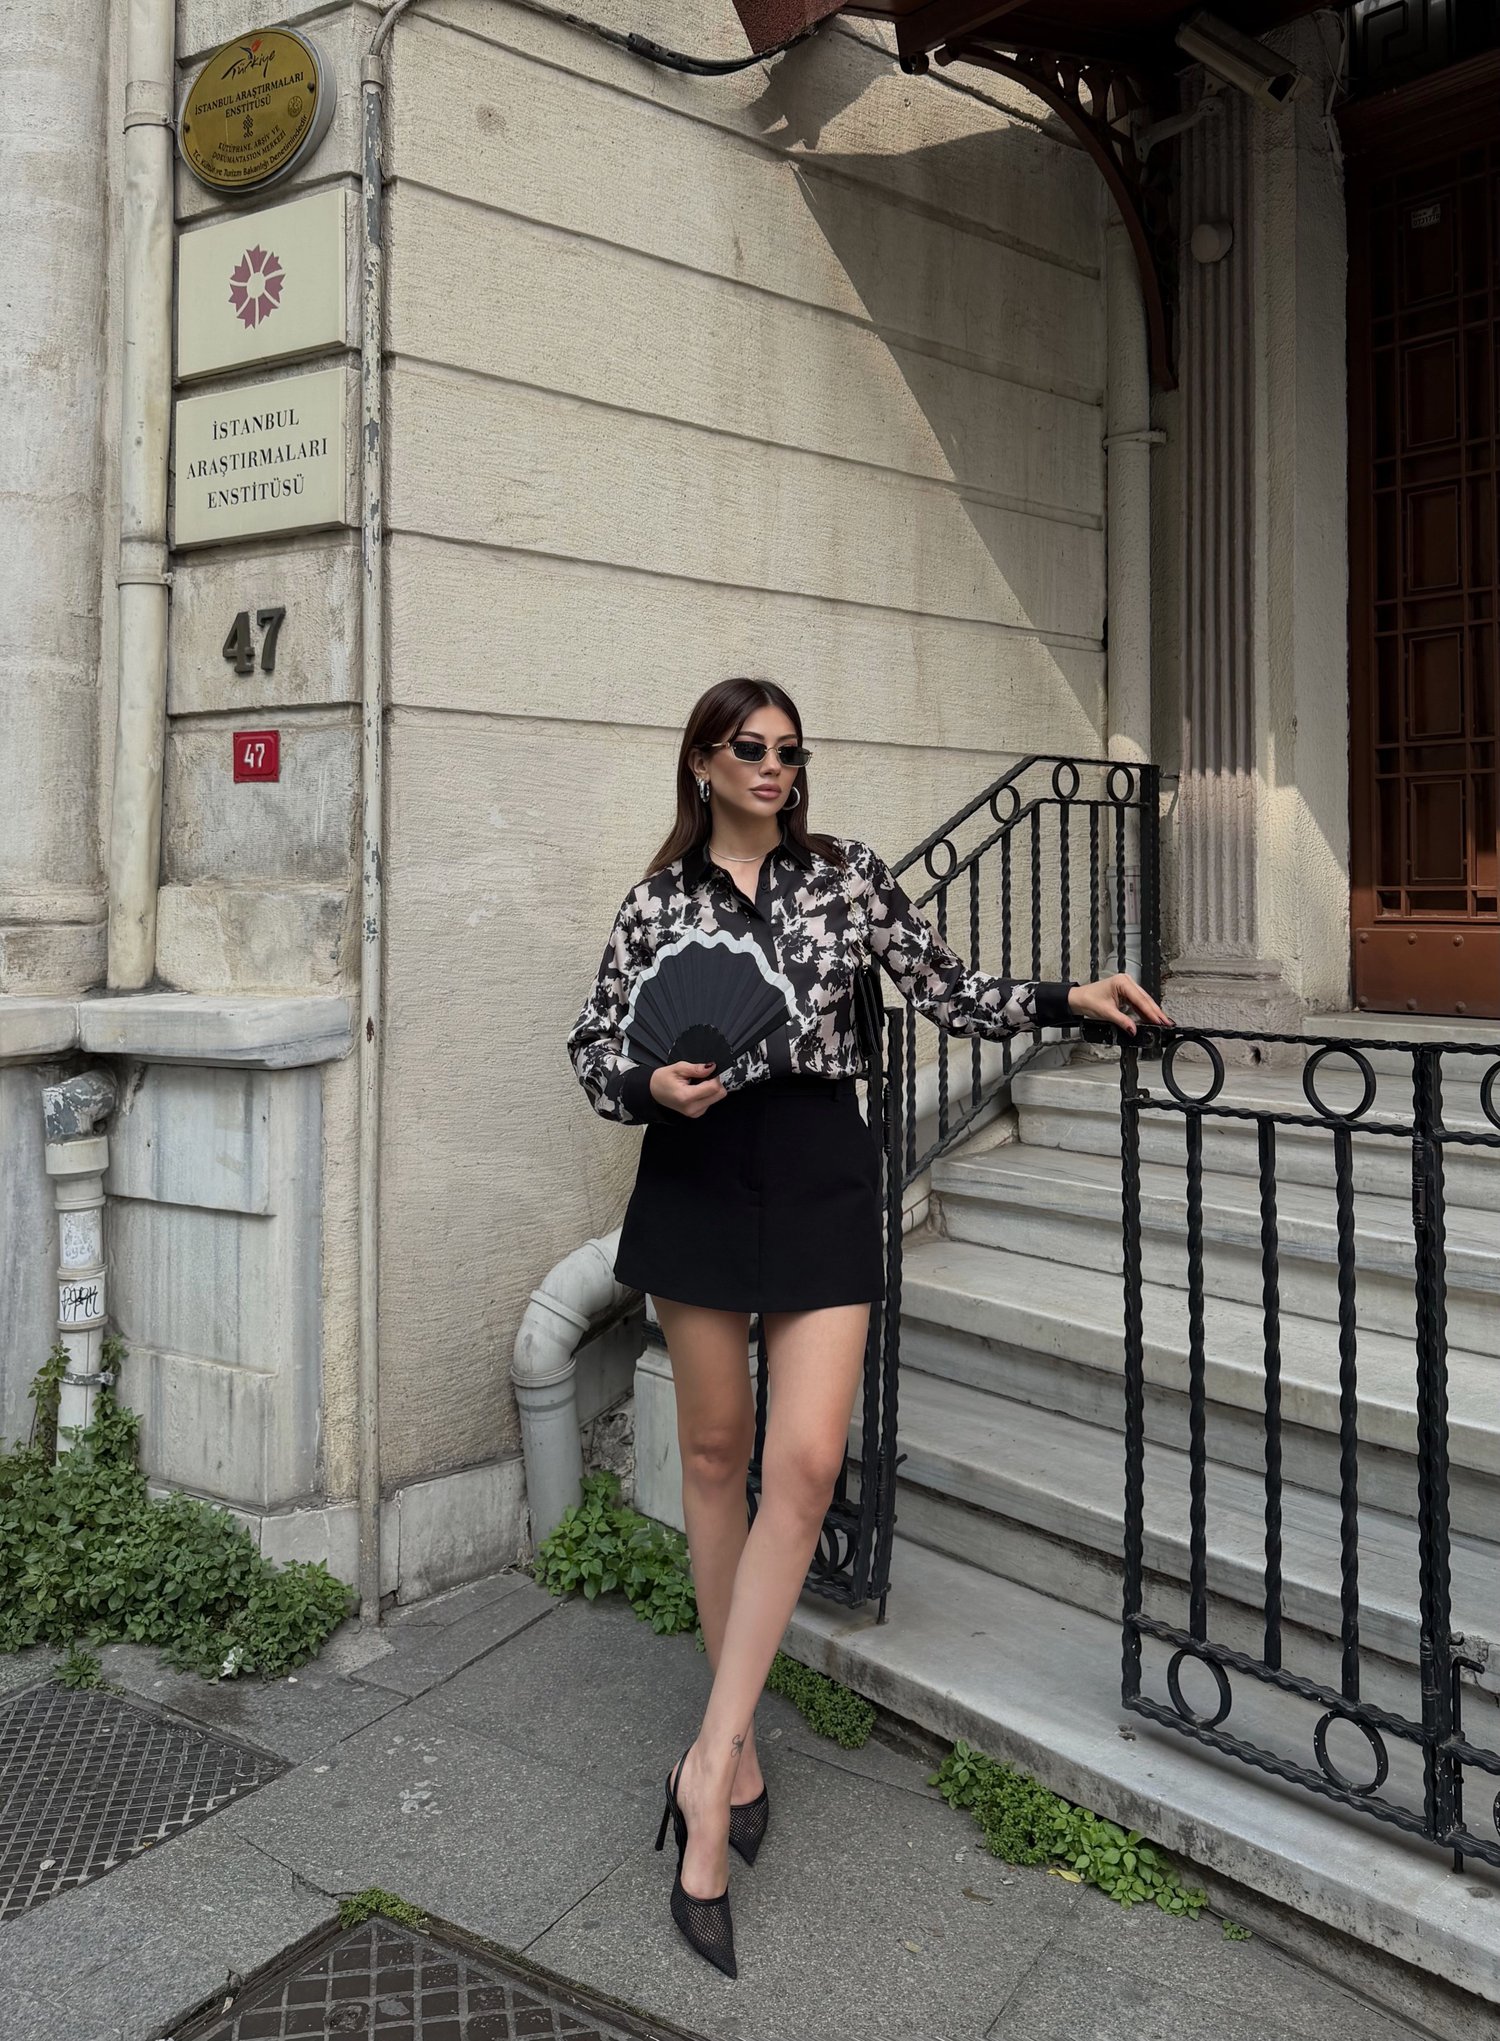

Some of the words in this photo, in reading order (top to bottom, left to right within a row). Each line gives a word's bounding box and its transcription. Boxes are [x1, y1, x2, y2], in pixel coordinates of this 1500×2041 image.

[221, 49, 276, 80] Türkiye
[195, 95, 234, 115] İSTANBUL
[235, 71, 304, 102] ARAŞTIRMALARI
[225, 95, 271, 118] ENSTİTÜSÜ
[270, 114, 308, 166] Denetimindedir
[212, 408, 299, 441] İSTANBUL
[187, 437, 328, 480] ARAŞTIRMALARI
[207, 473, 305, 509] ENSTİTÜSÜ
[223, 605, 287, 674] 47
[243, 742, 266, 769] 47
